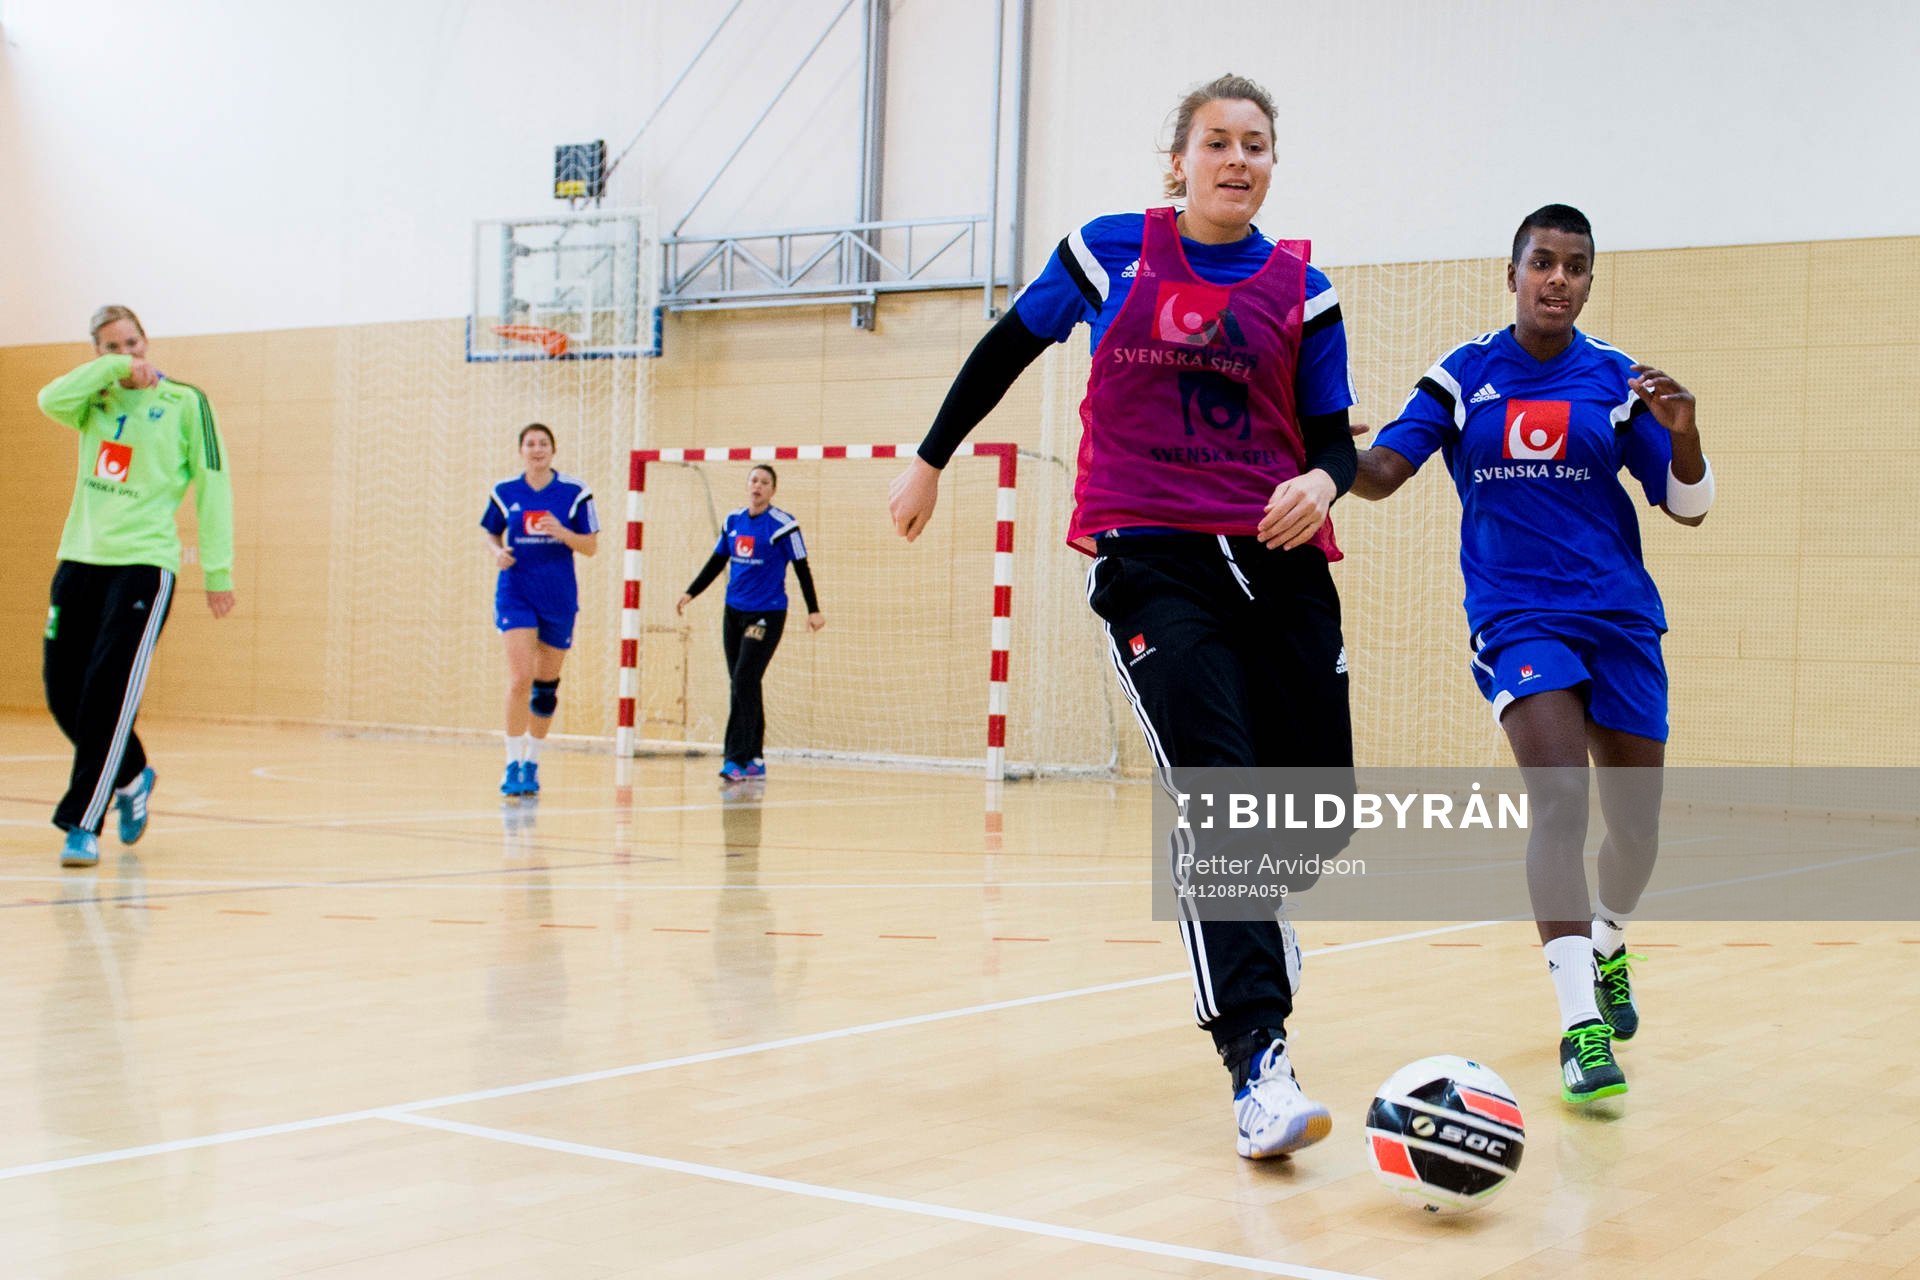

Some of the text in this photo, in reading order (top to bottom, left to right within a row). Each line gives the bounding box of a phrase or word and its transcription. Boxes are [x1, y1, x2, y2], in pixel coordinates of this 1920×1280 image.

[1121, 270, 1157, 278] adas
[1113, 347, 1253, 381] SVENSKA SPEL
[113, 414, 127, 440] 1
[1151, 447, 1281, 466] SVENSKA SPEL
[1473, 464, 1592, 483] SVENSKA SPEL
